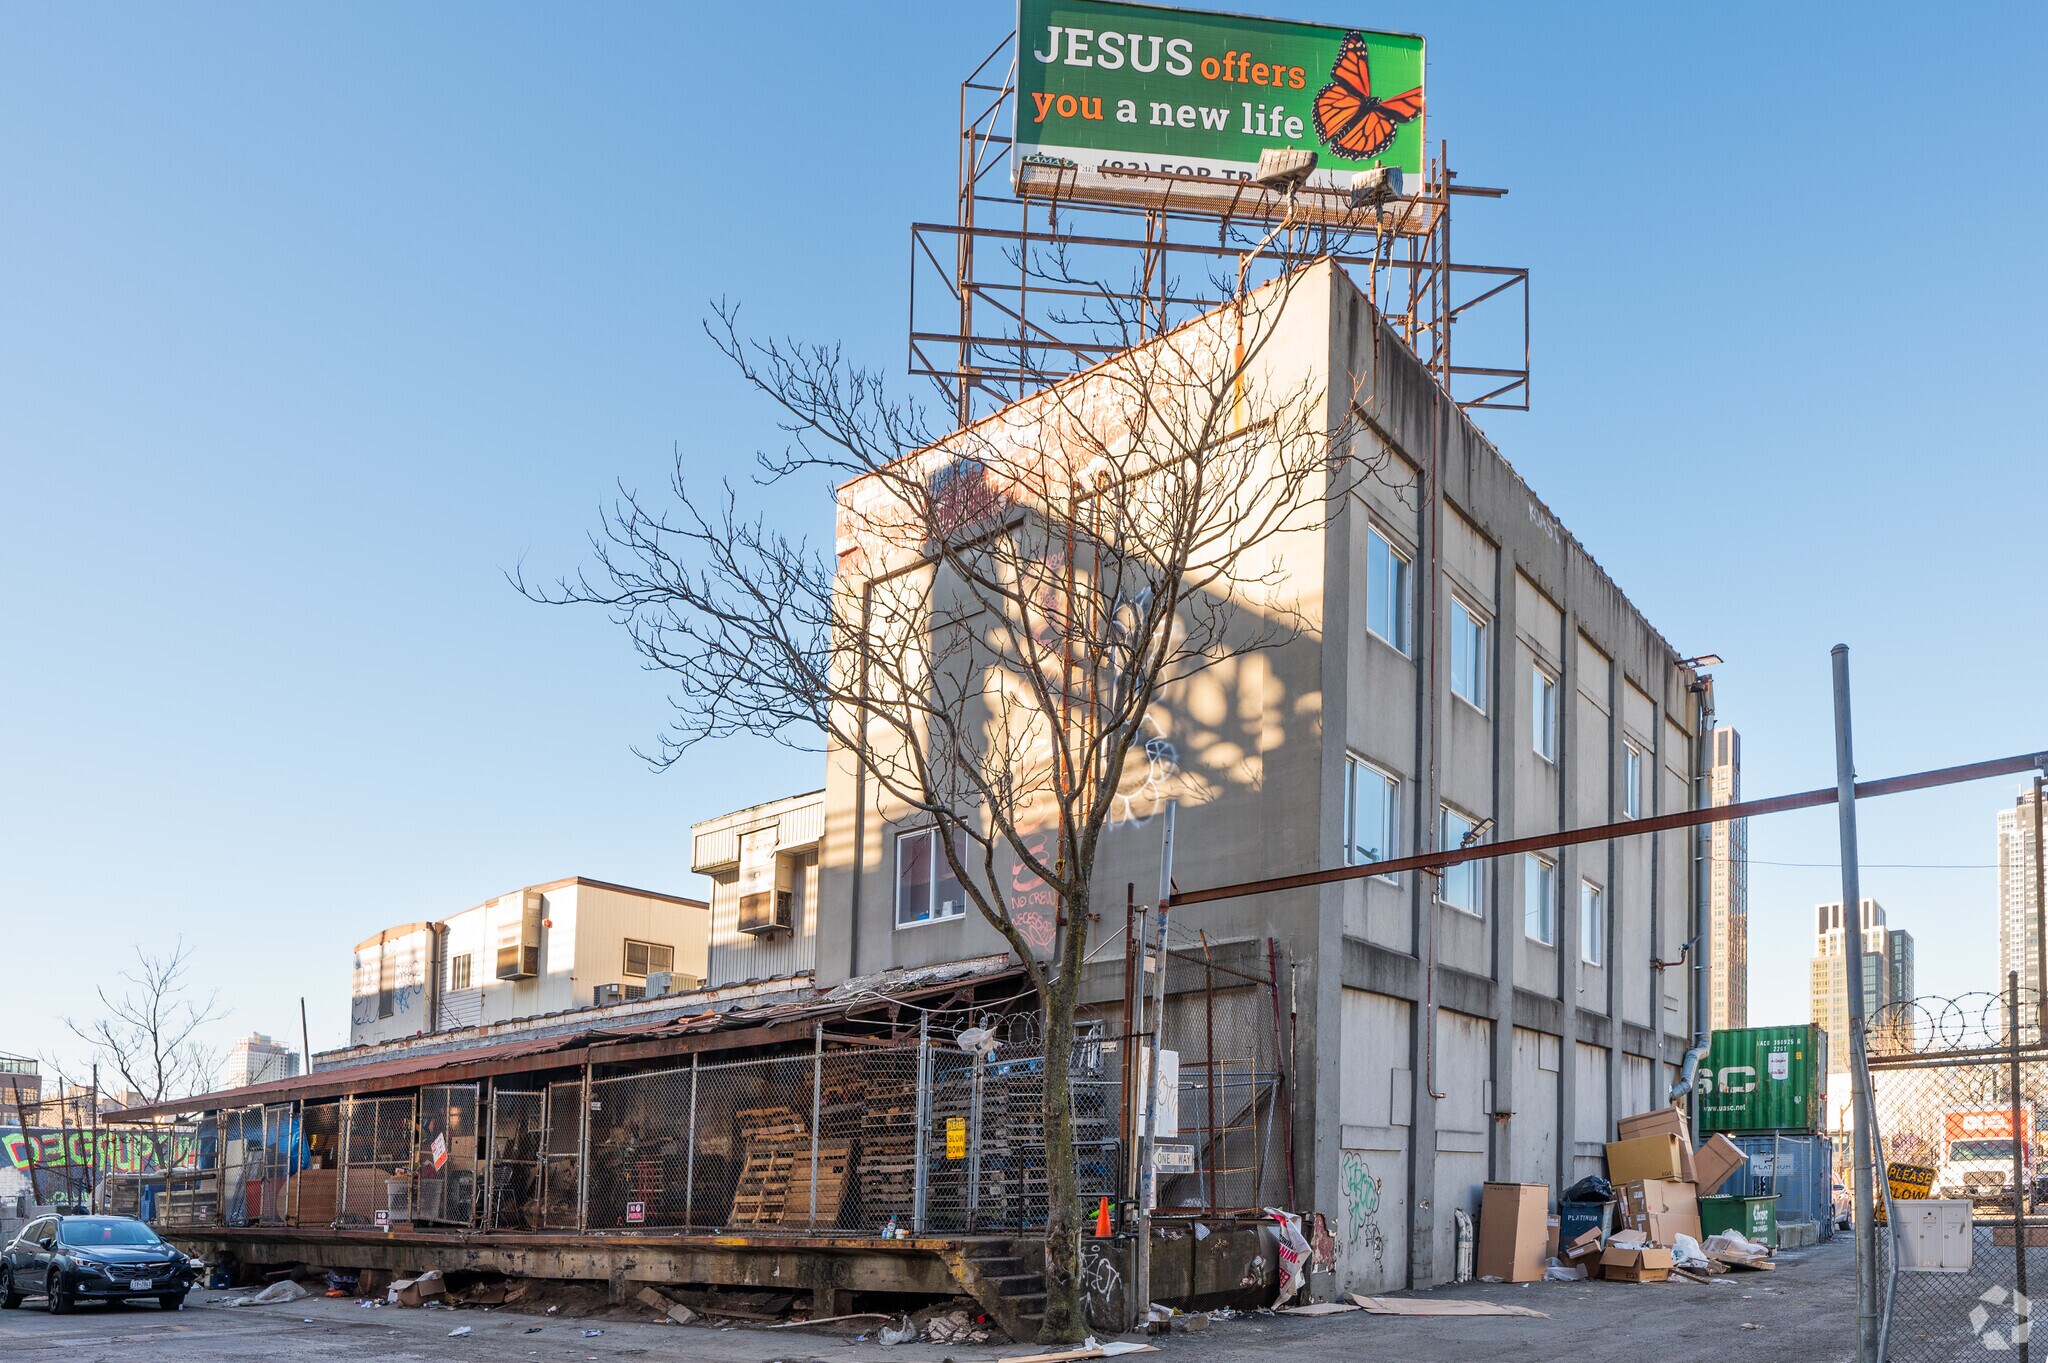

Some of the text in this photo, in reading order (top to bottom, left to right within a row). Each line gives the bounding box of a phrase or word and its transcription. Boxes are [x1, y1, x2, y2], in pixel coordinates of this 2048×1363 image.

[1033, 25, 1306, 89] JESUS offers
[1031, 91, 1304, 139] you a new life
[1025, 155, 1075, 168] LAMAR
[1160, 164, 1212, 179] FOR
[1011, 890, 1057, 909] NO CREW
[1157, 1153, 1191, 1164] ONE WAY
[1889, 1167, 1932, 1184] PLEASE
[1567, 1214, 1598, 1222] PLATINUM
[1625, 1272, 1639, 1280] EQ3
